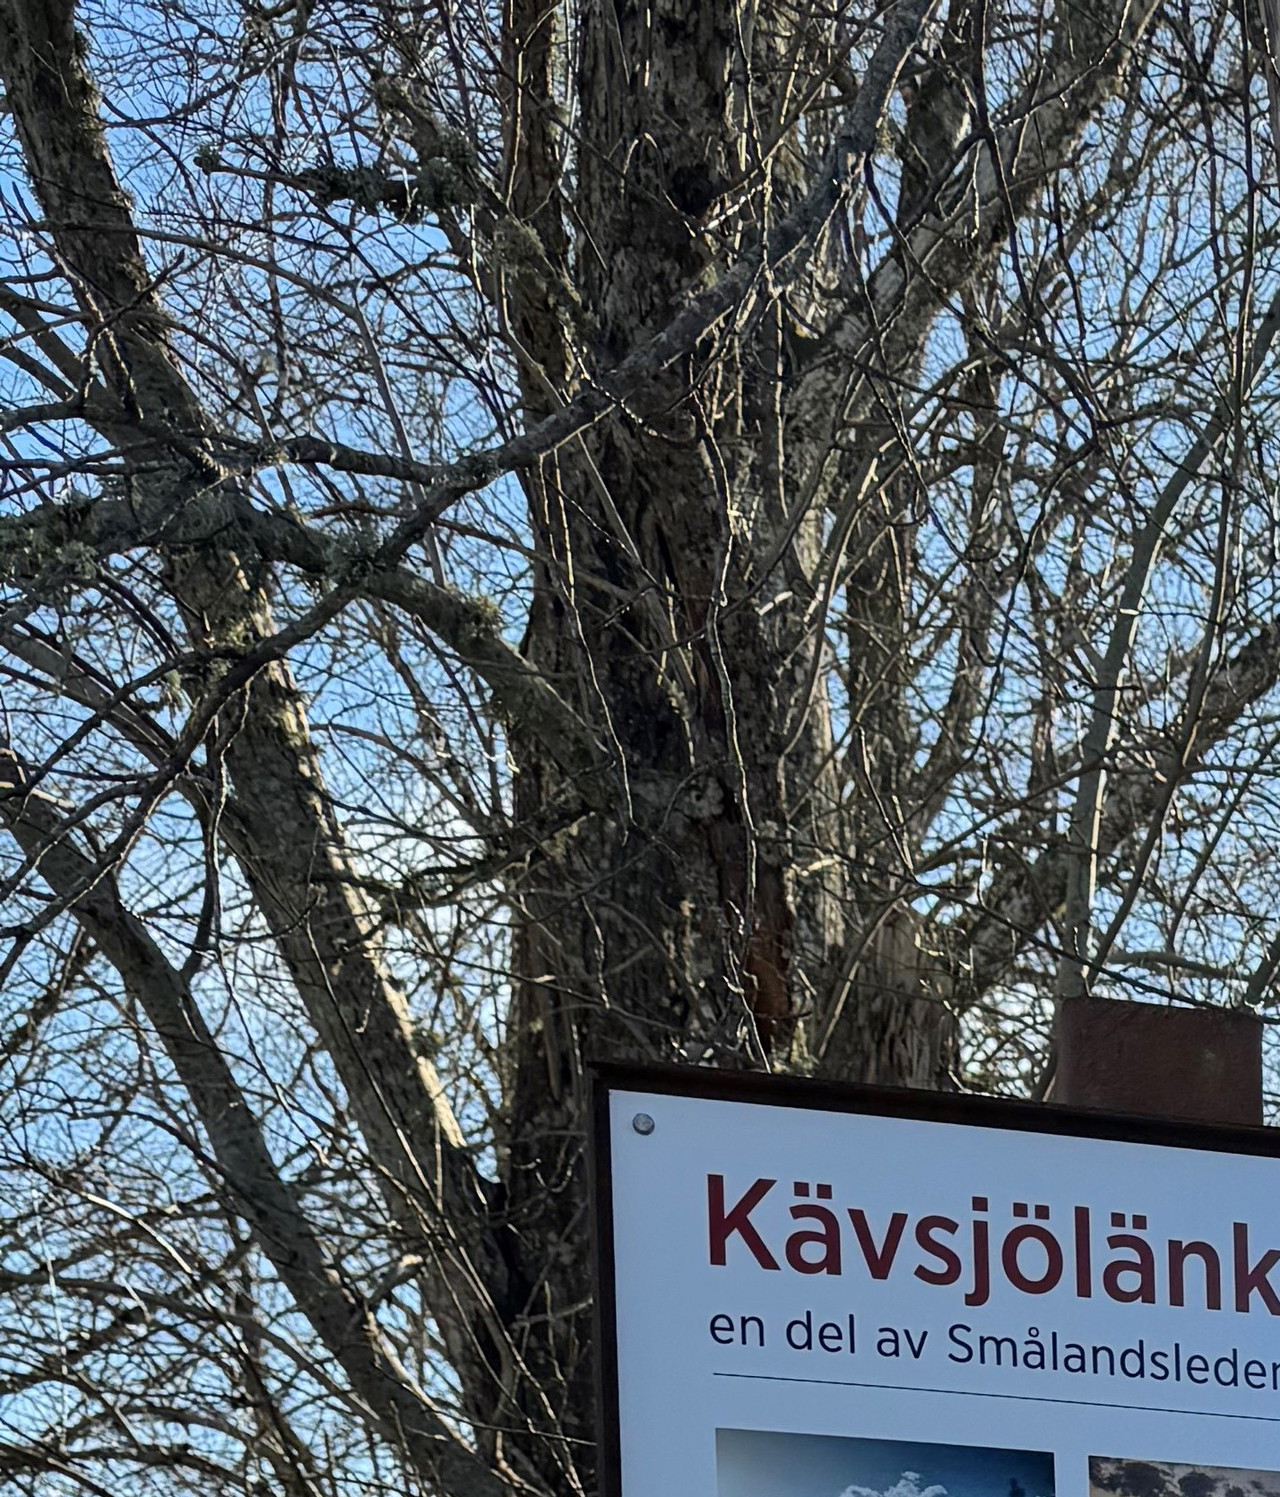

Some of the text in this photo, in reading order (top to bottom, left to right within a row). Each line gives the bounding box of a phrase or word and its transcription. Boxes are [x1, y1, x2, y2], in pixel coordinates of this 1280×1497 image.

[708, 1312, 766, 1348] en
[784, 1308, 856, 1355] del
[875, 1325, 929, 1360] av
